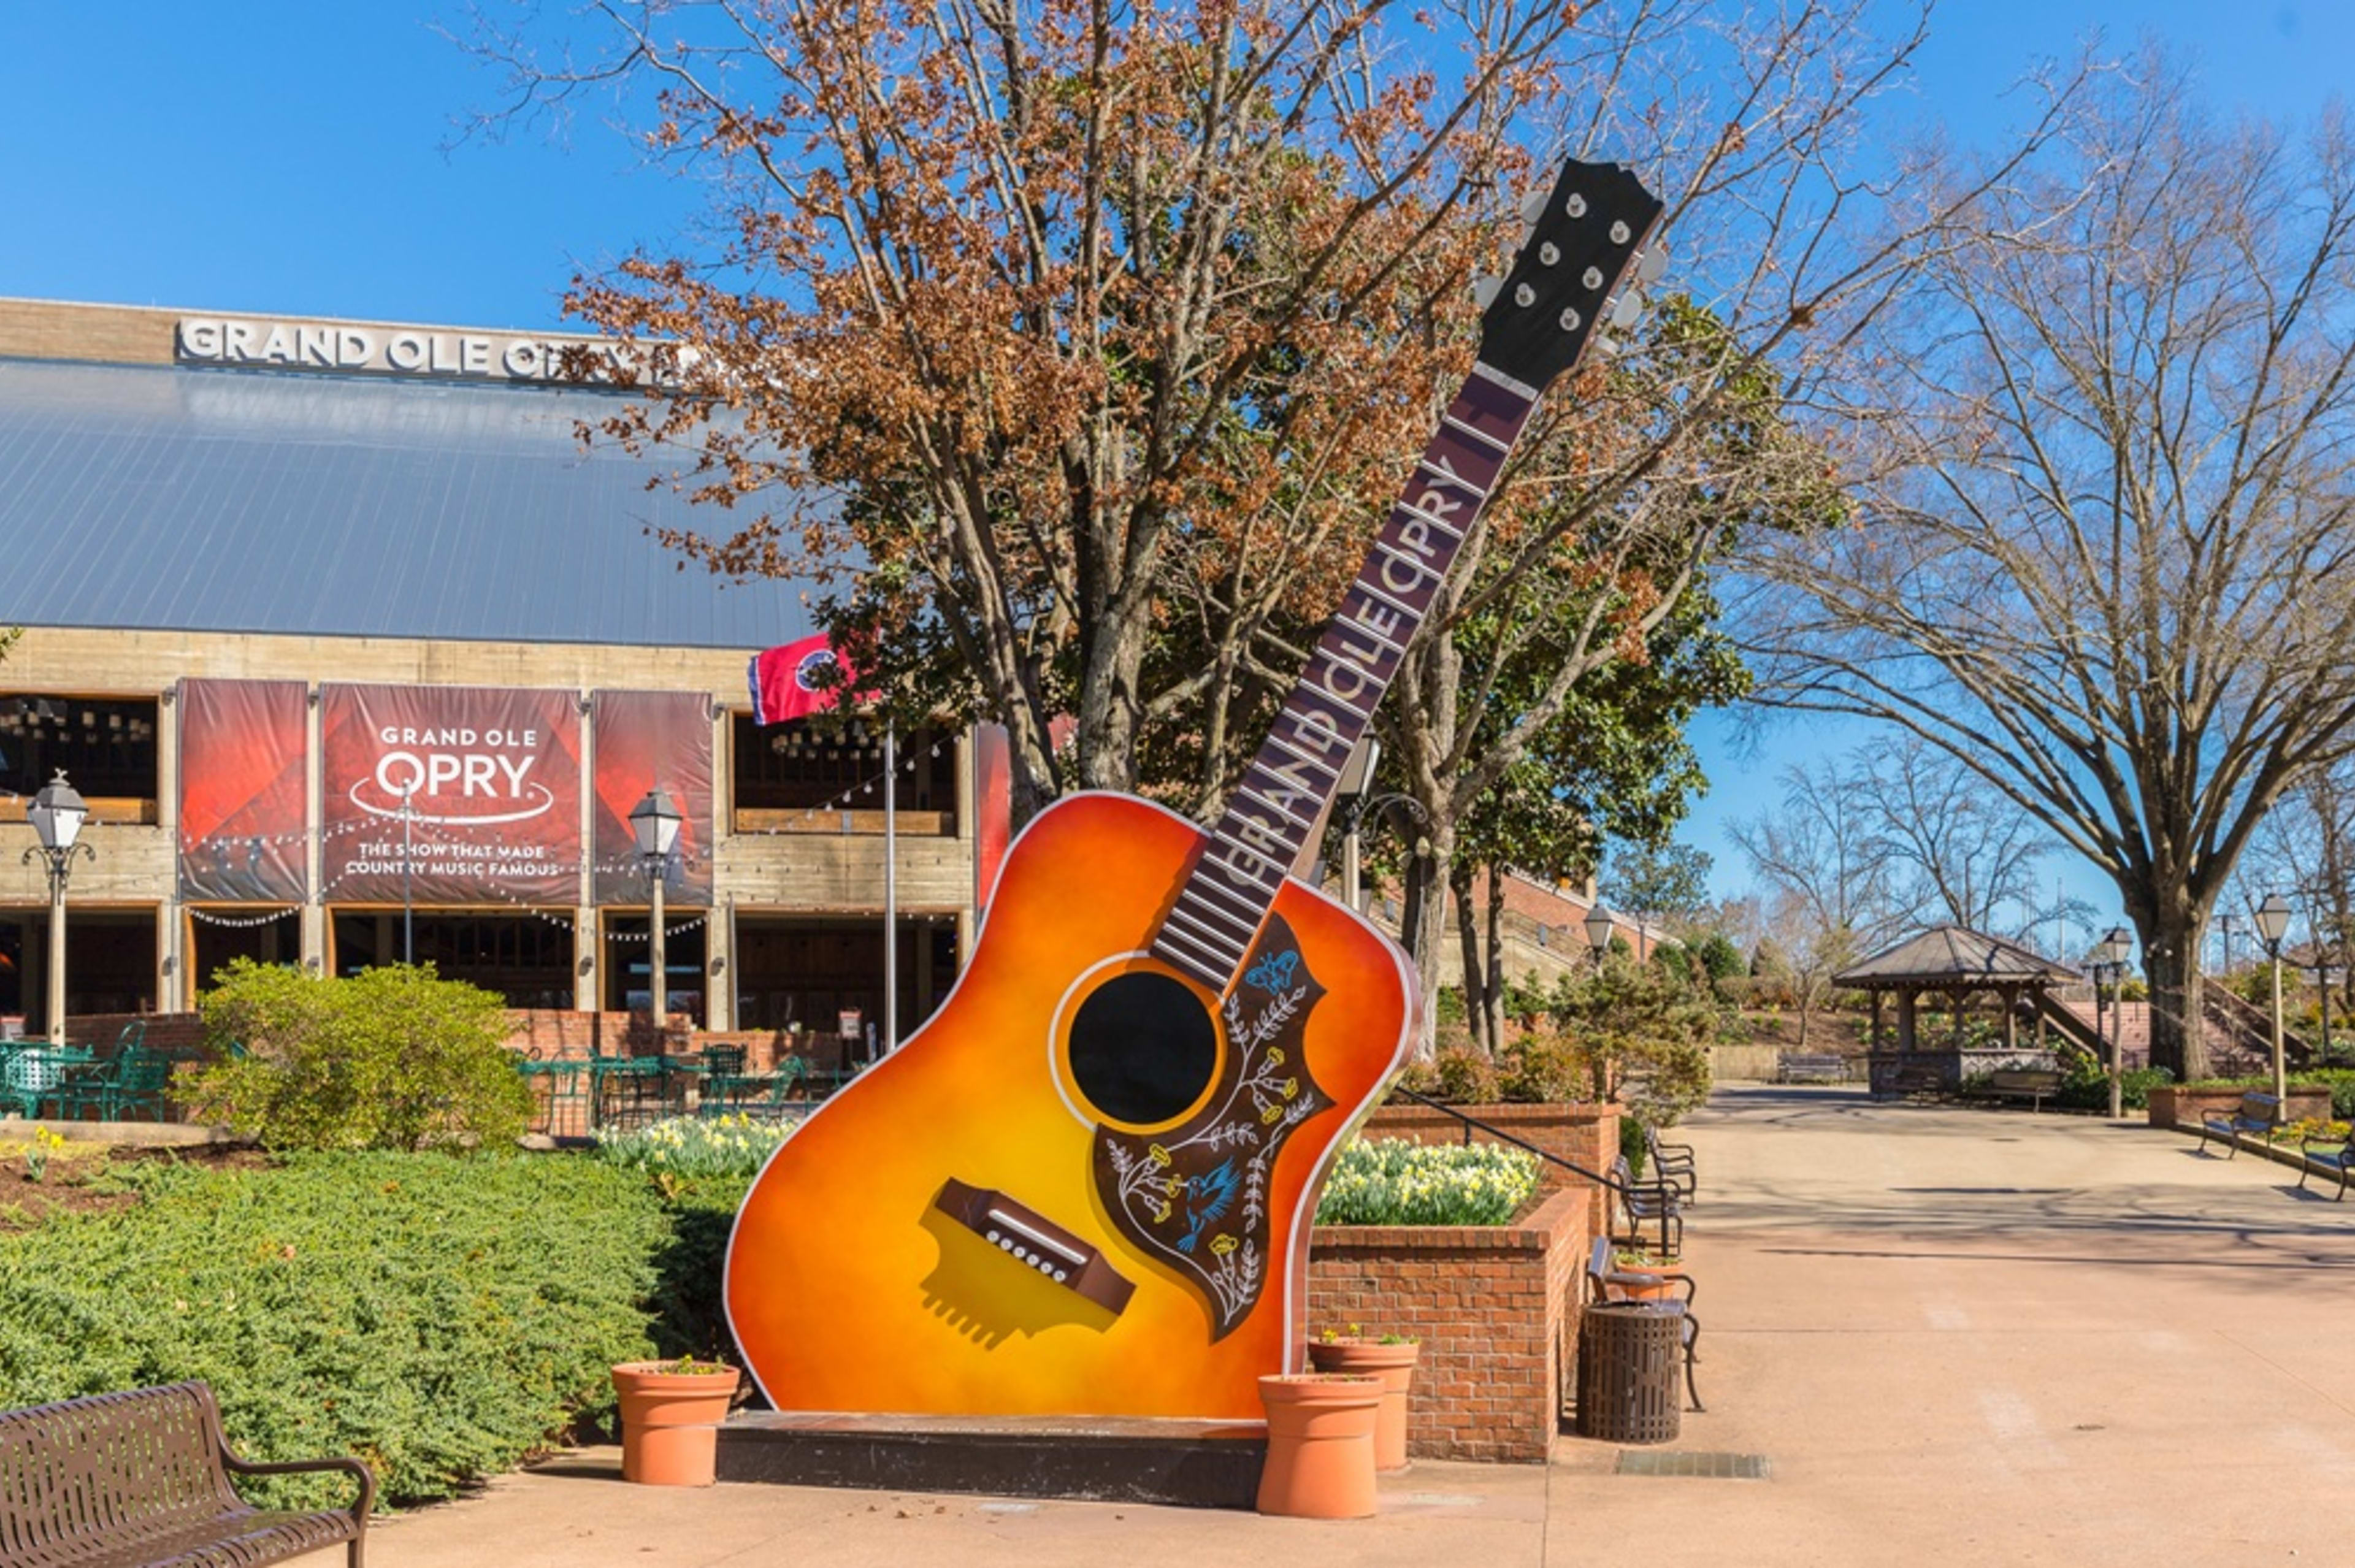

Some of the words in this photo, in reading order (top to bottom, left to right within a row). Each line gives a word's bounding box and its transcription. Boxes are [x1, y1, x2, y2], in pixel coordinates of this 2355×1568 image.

[178, 319, 376, 368] GRAND
[386, 331, 490, 375] OLE
[1227, 709, 1338, 886] GRAND
[1323, 597, 1403, 702] OLE
[1381, 454, 1463, 594] OPRY
[380, 727, 477, 746] GRAND
[485, 730, 537, 746] OLE
[375, 751, 535, 798] OPRY
[359, 843, 391, 857] THE
[395, 843, 446, 857] SHOW
[451, 844, 492, 858] THAT
[497, 846, 544, 859] MADE
[429, 862, 483, 876] MUSIC
[489, 863, 558, 876] FAMOUS
